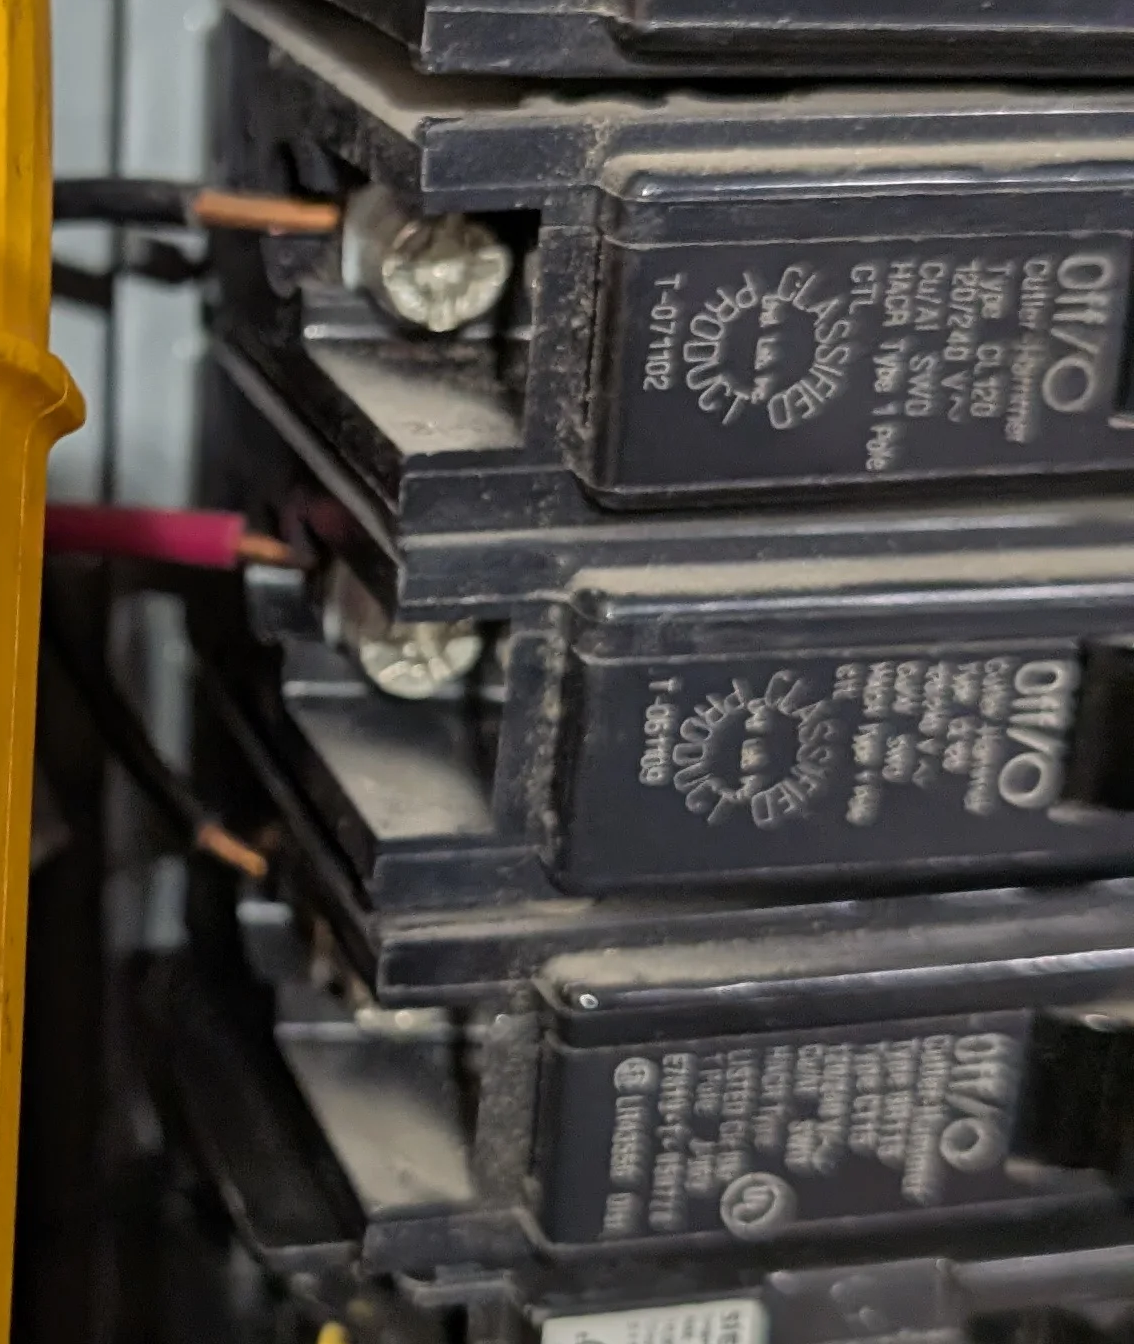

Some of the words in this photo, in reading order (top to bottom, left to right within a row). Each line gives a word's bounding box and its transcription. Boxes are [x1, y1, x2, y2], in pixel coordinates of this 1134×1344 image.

[643, 272, 686, 391] T-071102
[683, 270, 758, 427] PRODUCT
[768, 264, 852, 430] CLASSIFIED
